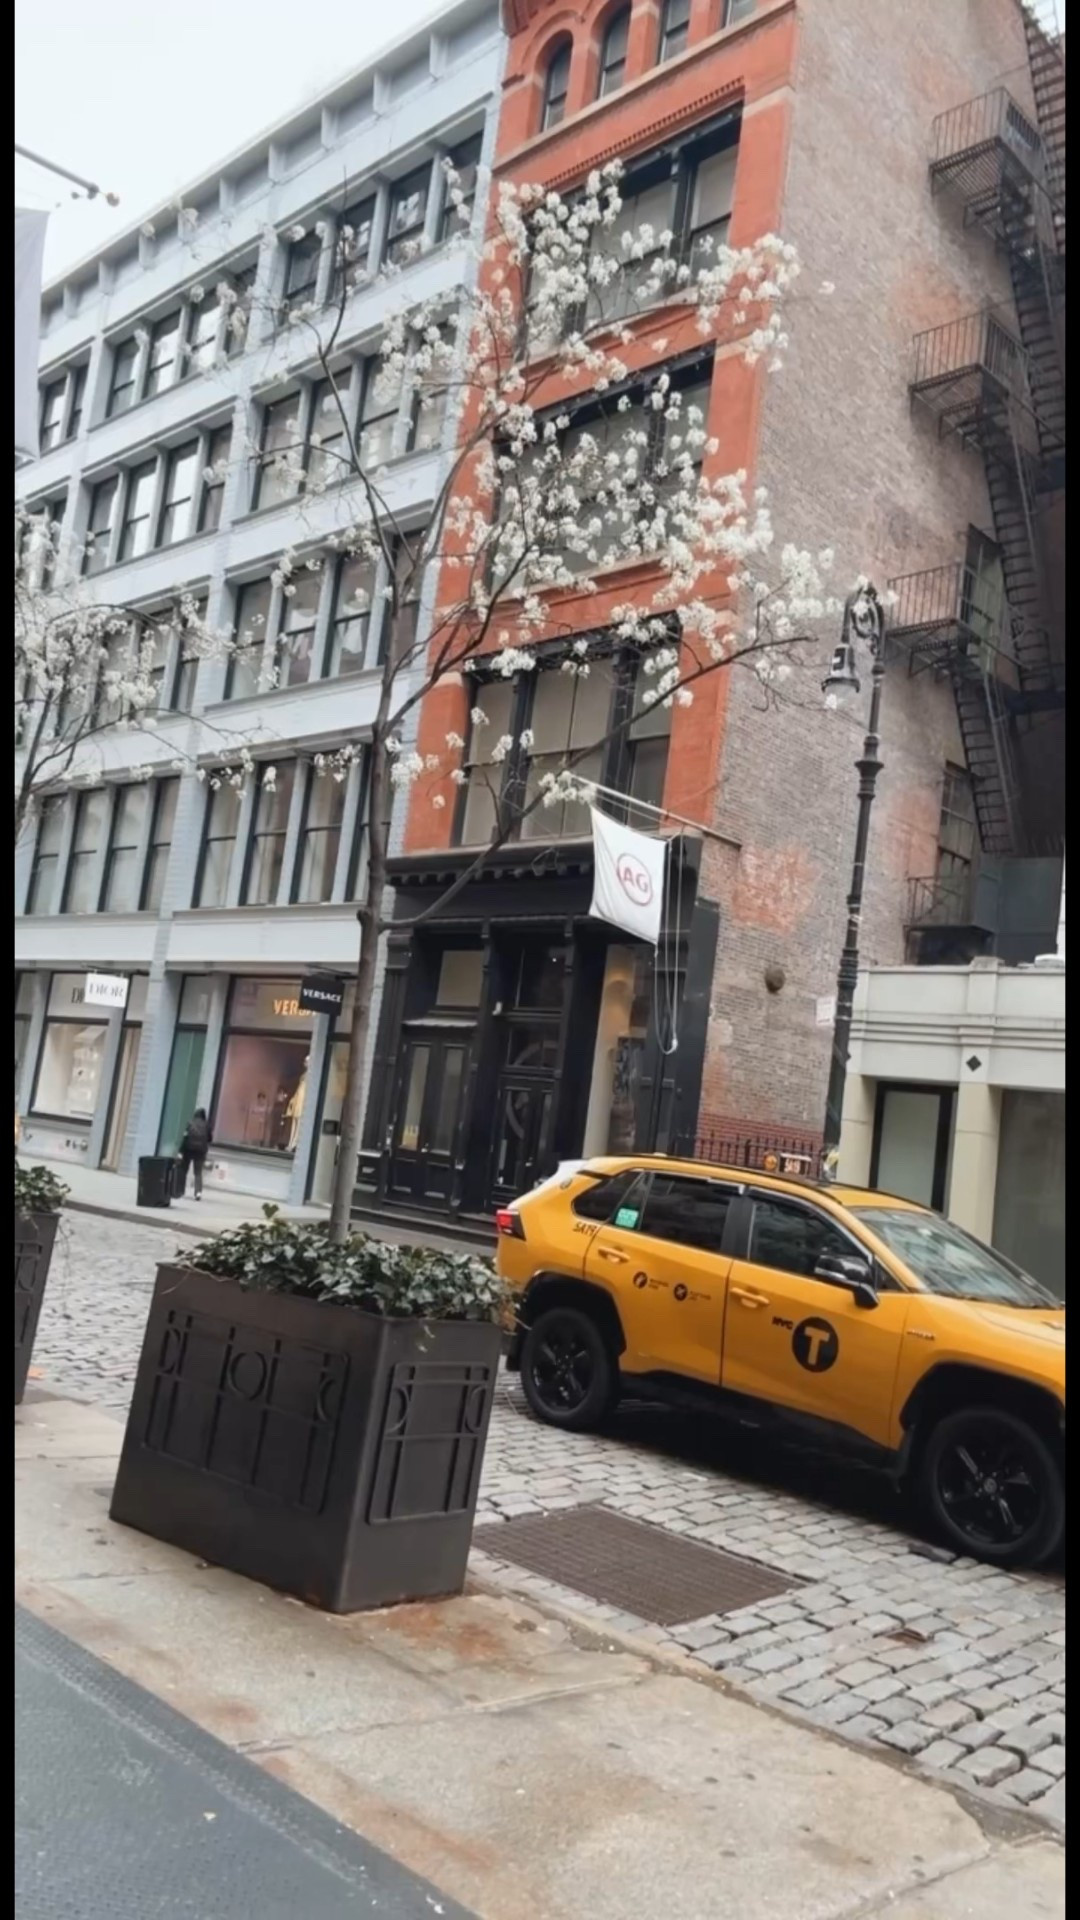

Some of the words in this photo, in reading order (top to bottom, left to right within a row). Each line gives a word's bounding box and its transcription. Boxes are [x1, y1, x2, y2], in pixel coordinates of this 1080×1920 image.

[623, 866, 649, 893] AG
[303, 988, 342, 1003] VERSACE
[804, 1326, 830, 1366] T
